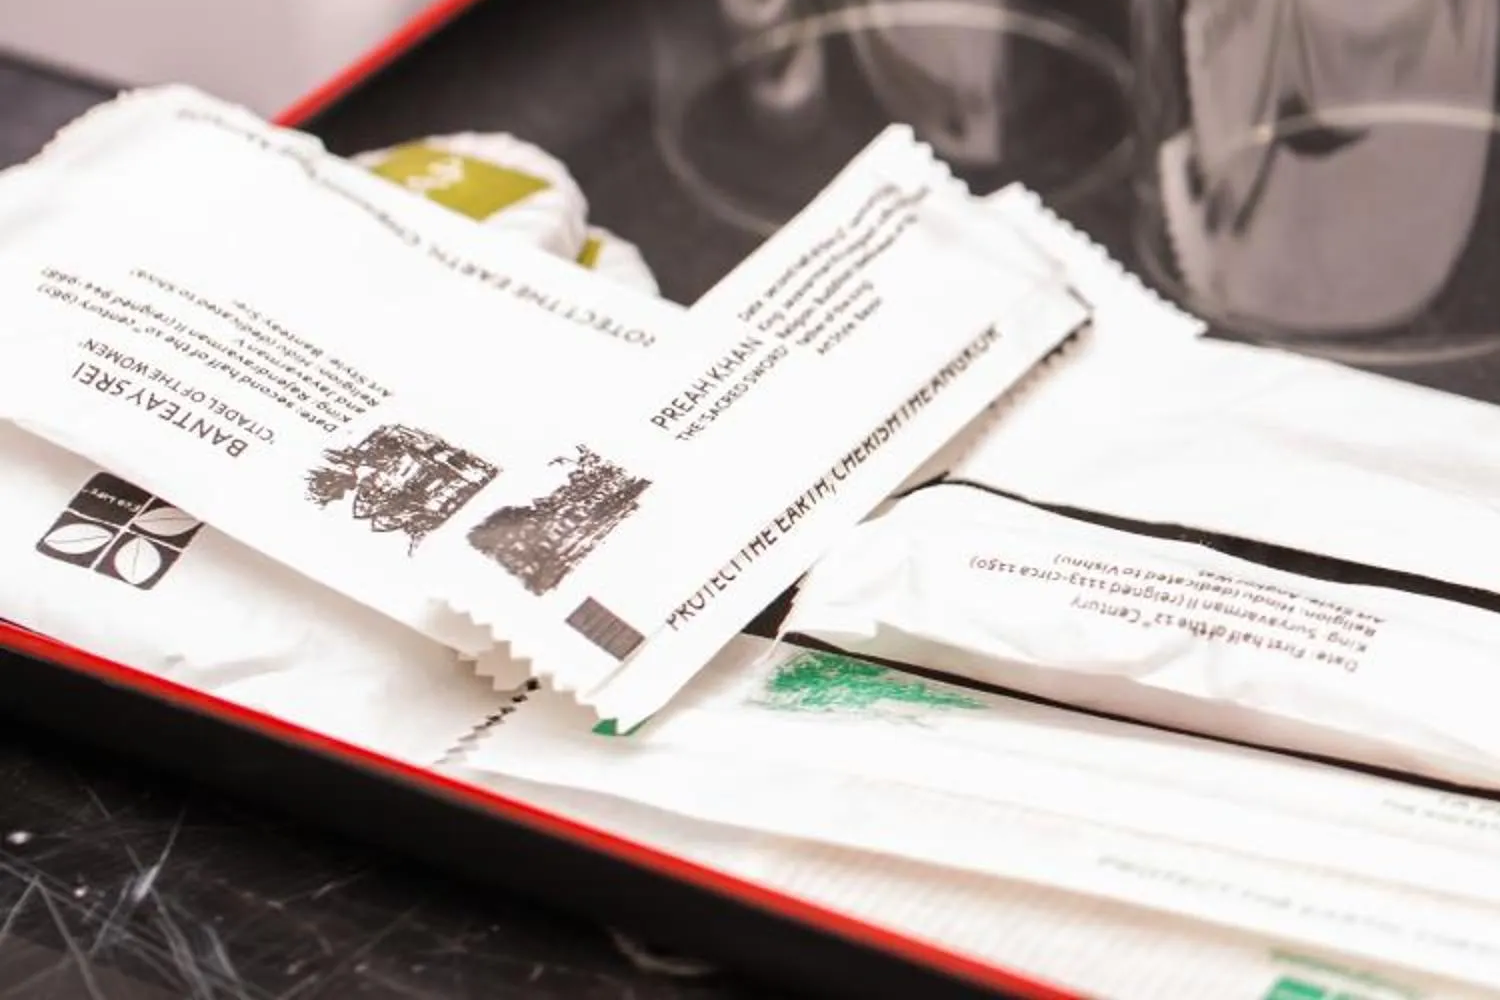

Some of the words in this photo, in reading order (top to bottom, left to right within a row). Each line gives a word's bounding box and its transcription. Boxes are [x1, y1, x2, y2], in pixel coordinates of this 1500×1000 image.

[163, 335, 192, 353] the
[71, 361, 133, 396] SREI
[147, 367, 182, 393] THE
[206, 358, 241, 379] half
[179, 387, 207, 404] OF
[237, 375, 295, 409] second
[649, 378, 715, 430] PREAH
[705, 336, 764, 383] KHAN
[125, 387, 249, 458] BANTEAY
[1121, 567, 1142, 579] to
[1108, 581, 1185, 607] (reigned
[1070, 596, 1142, 624] Century
[1201, 599, 1317, 640] Suryavarman
[1177, 617, 1208, 638] the
[1226, 630, 1264, 649] half
[1266, 638, 1307, 660] First
